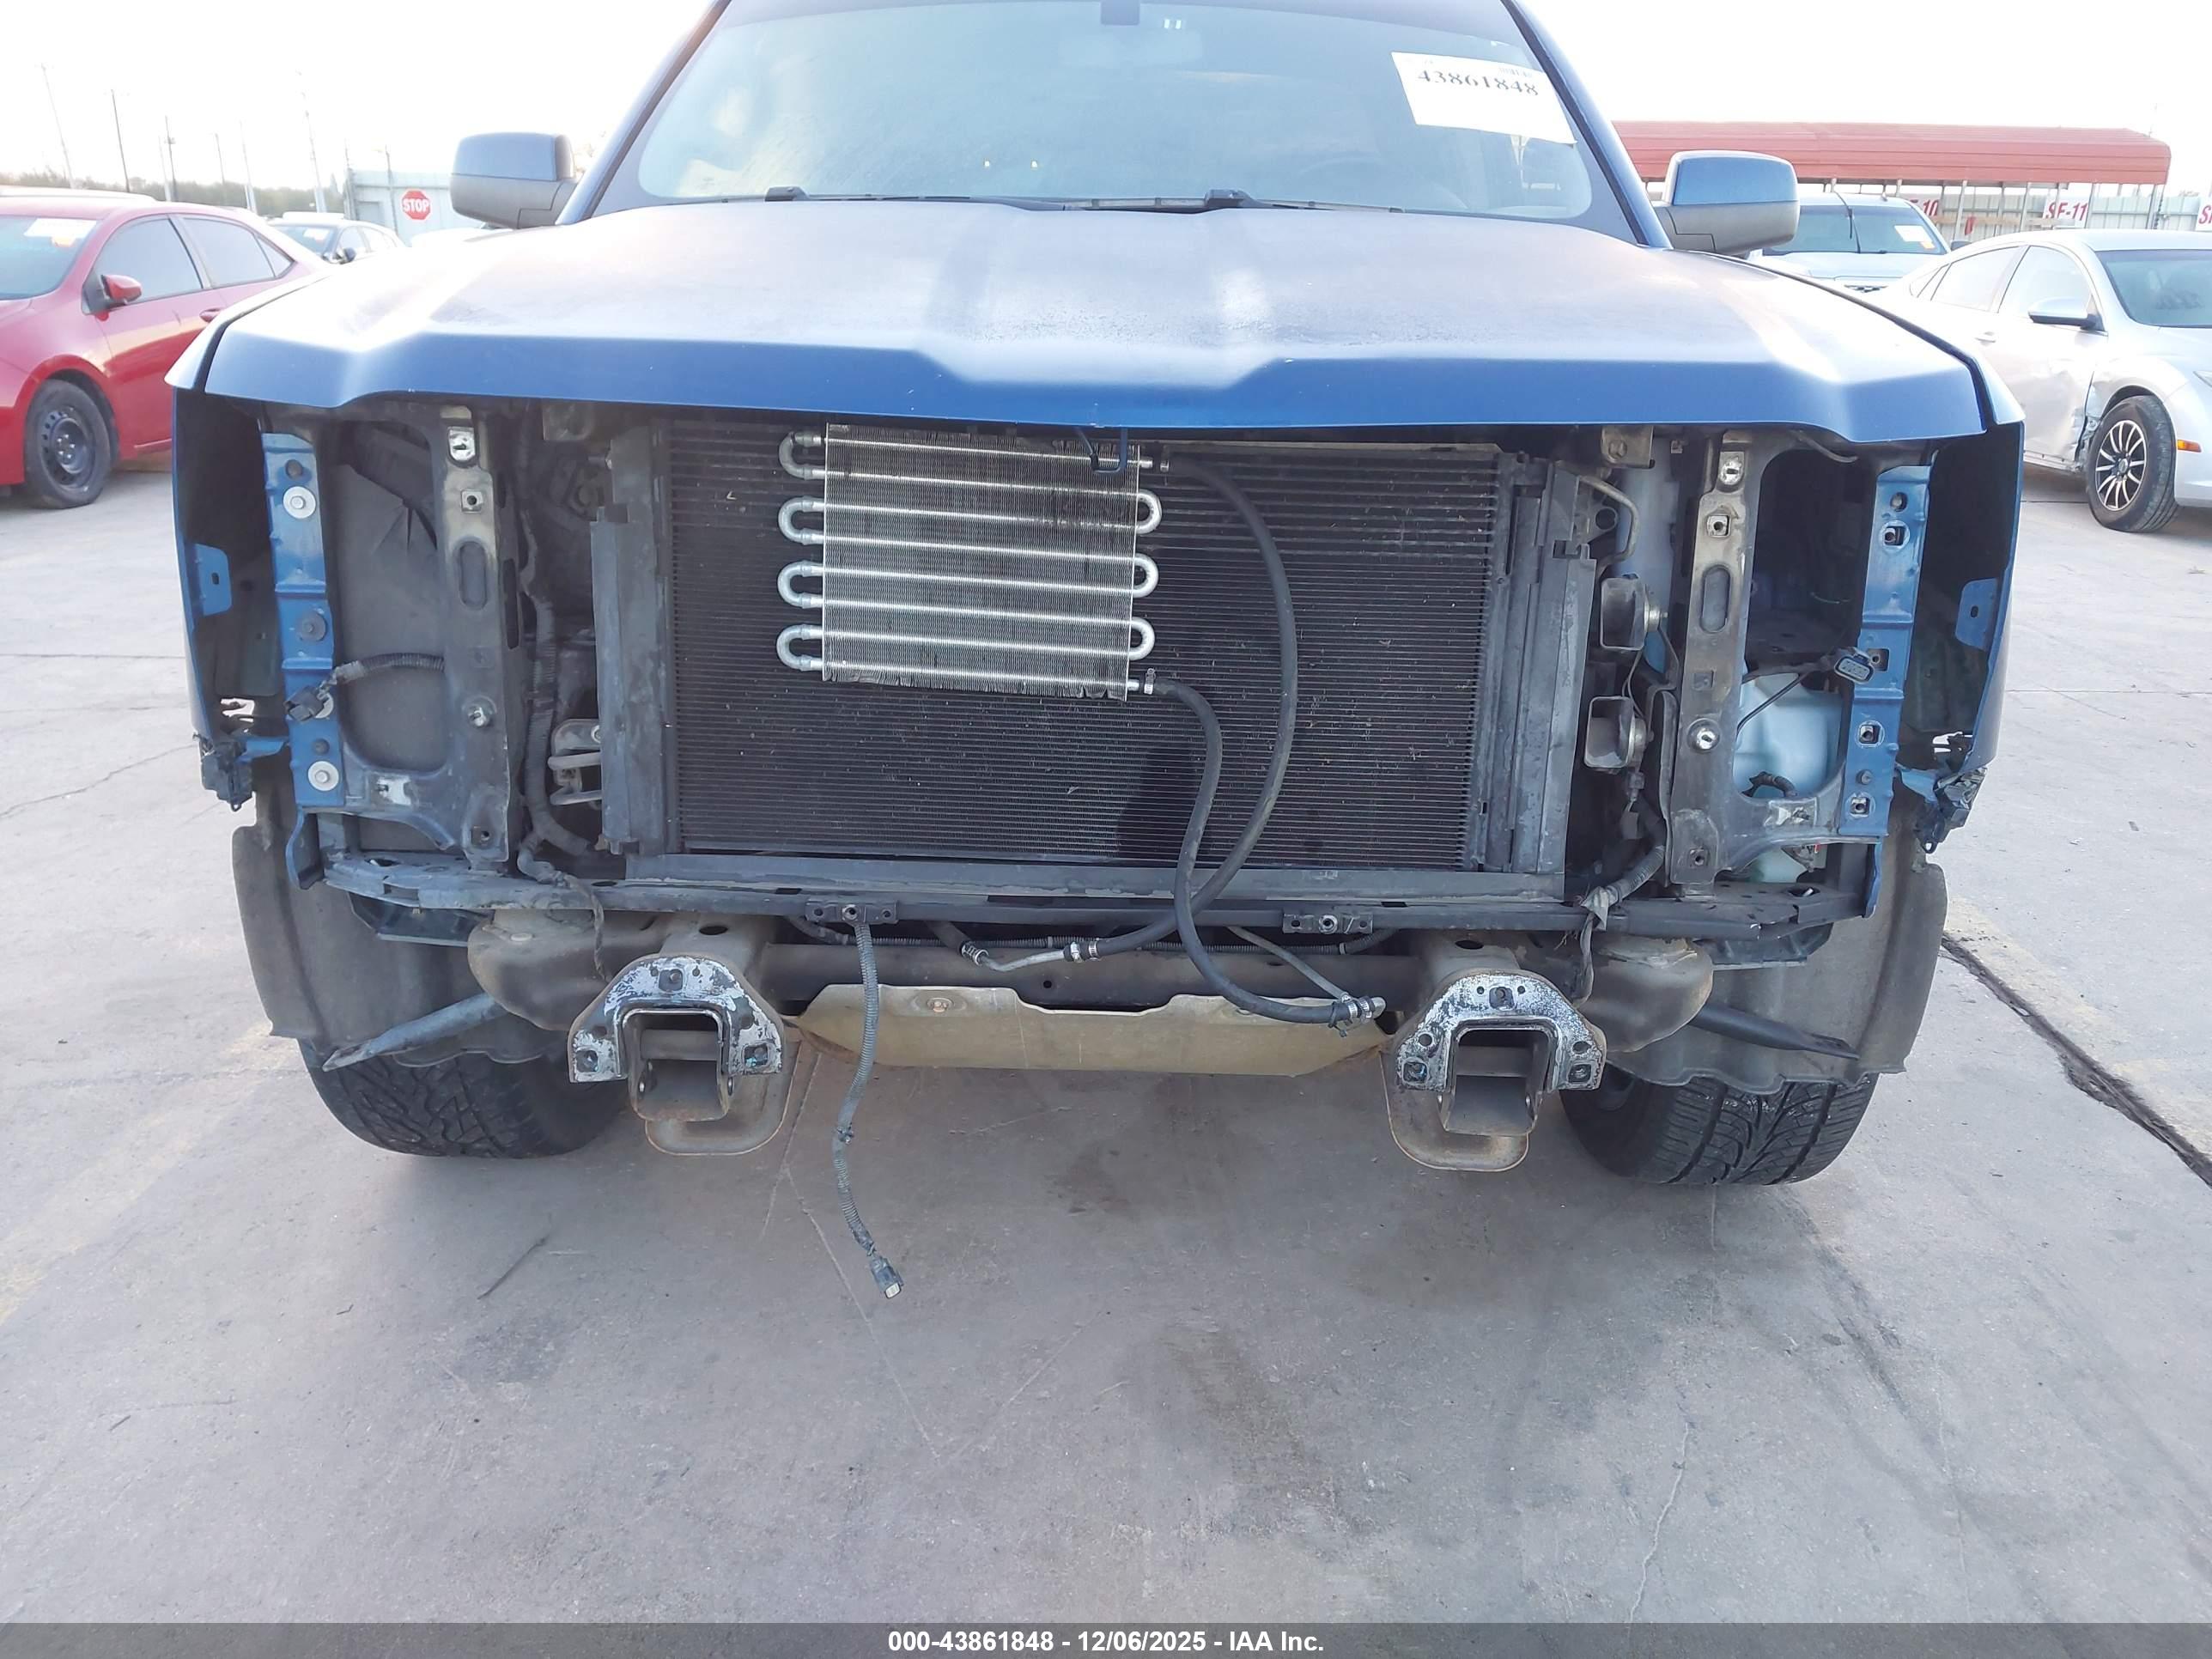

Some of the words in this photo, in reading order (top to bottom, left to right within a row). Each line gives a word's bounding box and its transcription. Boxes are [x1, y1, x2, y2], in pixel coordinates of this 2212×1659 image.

[1418, 70, 1539, 96] 43861848
[403, 198, 429, 213] STOP
[2045, 202, 2088, 222] SF-11
[2198, 204, 2212, 224] S
